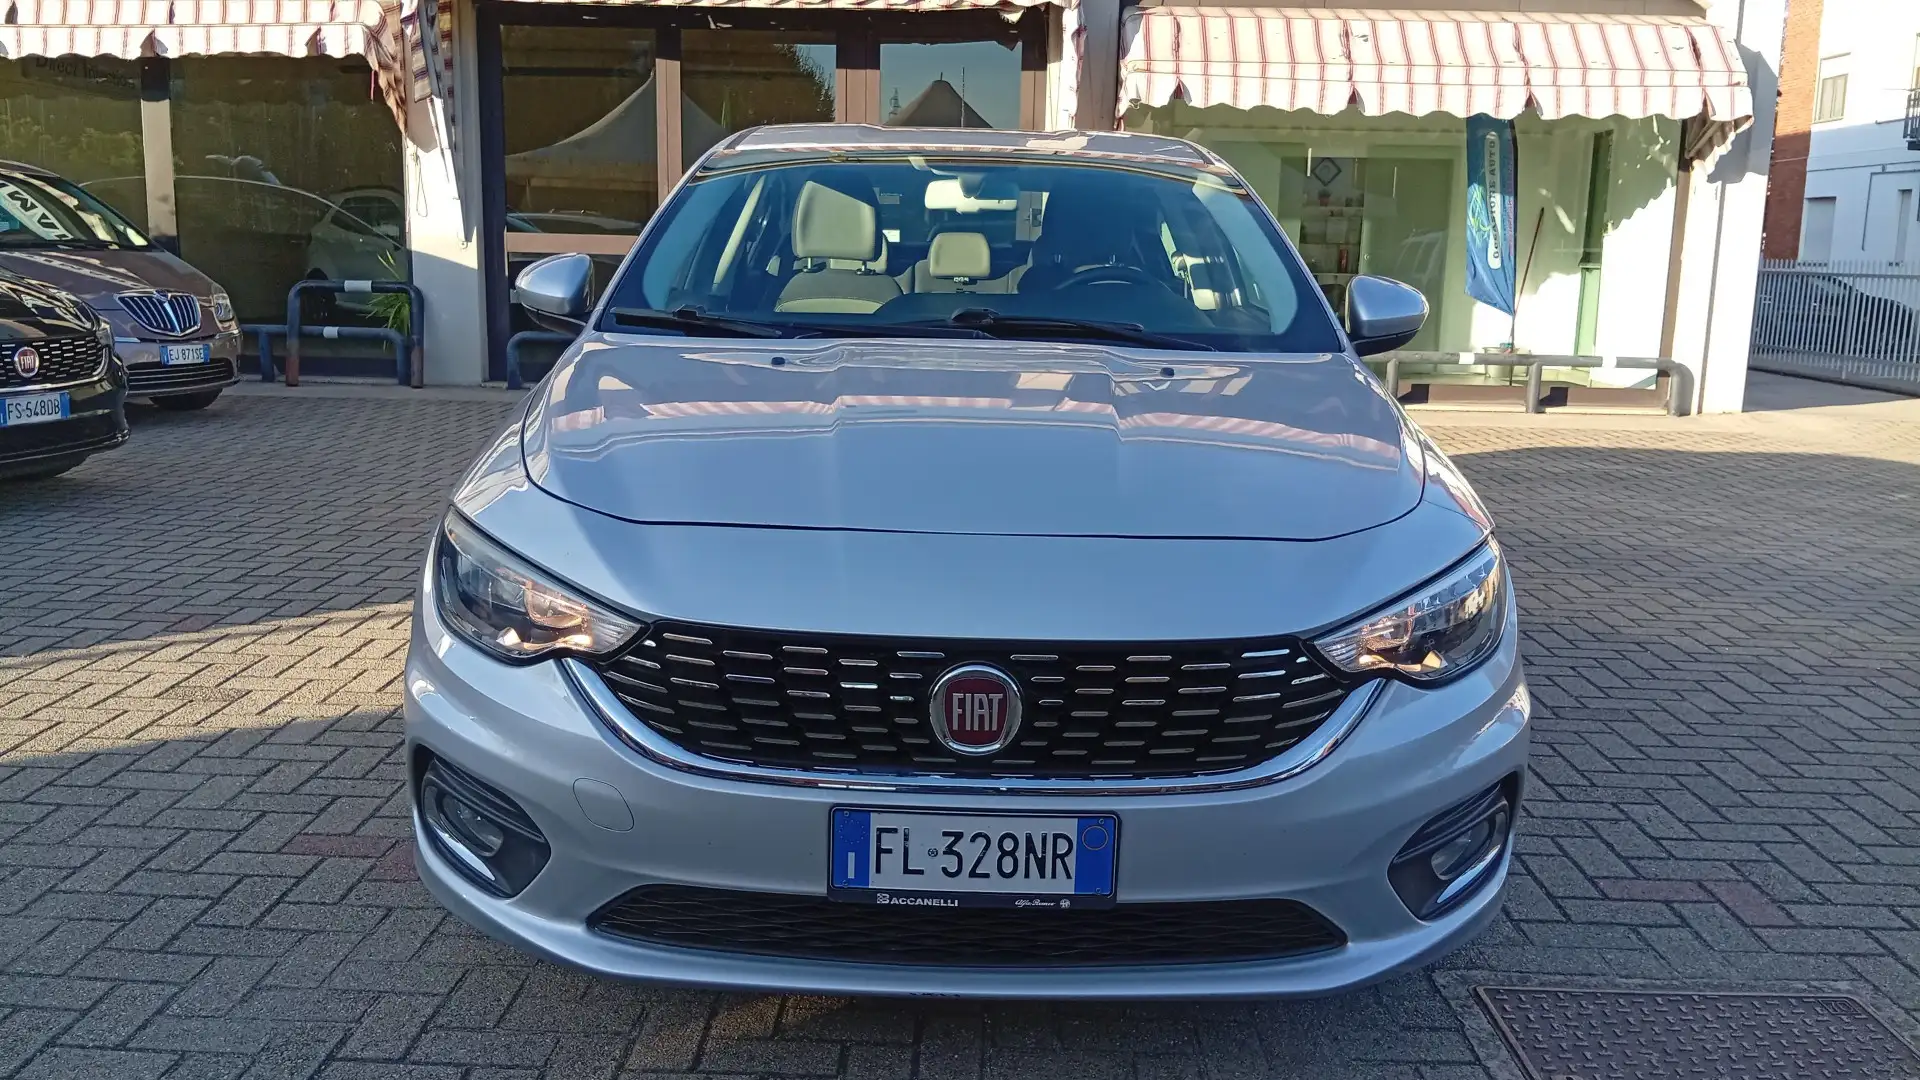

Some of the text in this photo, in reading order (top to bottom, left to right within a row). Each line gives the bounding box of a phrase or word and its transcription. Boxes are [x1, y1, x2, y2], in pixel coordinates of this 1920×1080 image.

[20, 355, 34, 370] FIAT
[952, 693, 1003, 731] FIAT
[941, 830, 1074, 879] 328NR
[1015, 899, 1056, 908] Alfa Romeo
